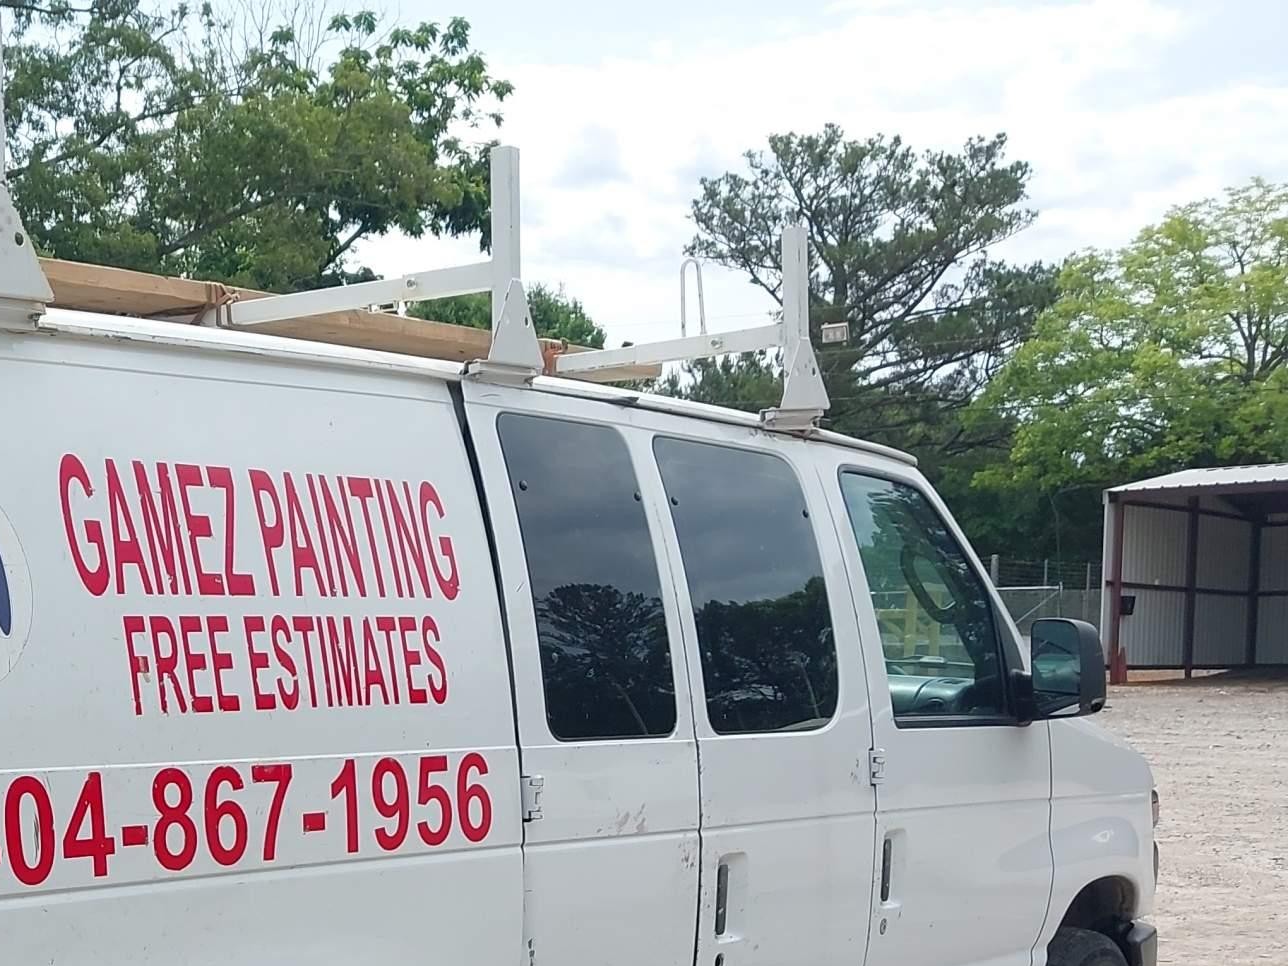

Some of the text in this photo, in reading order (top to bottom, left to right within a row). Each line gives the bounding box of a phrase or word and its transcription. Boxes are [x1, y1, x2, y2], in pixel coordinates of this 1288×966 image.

[58, 454, 461, 601] GAMEZ PAINTING
[122, 614, 449, 716] FREE ESTIMATES
